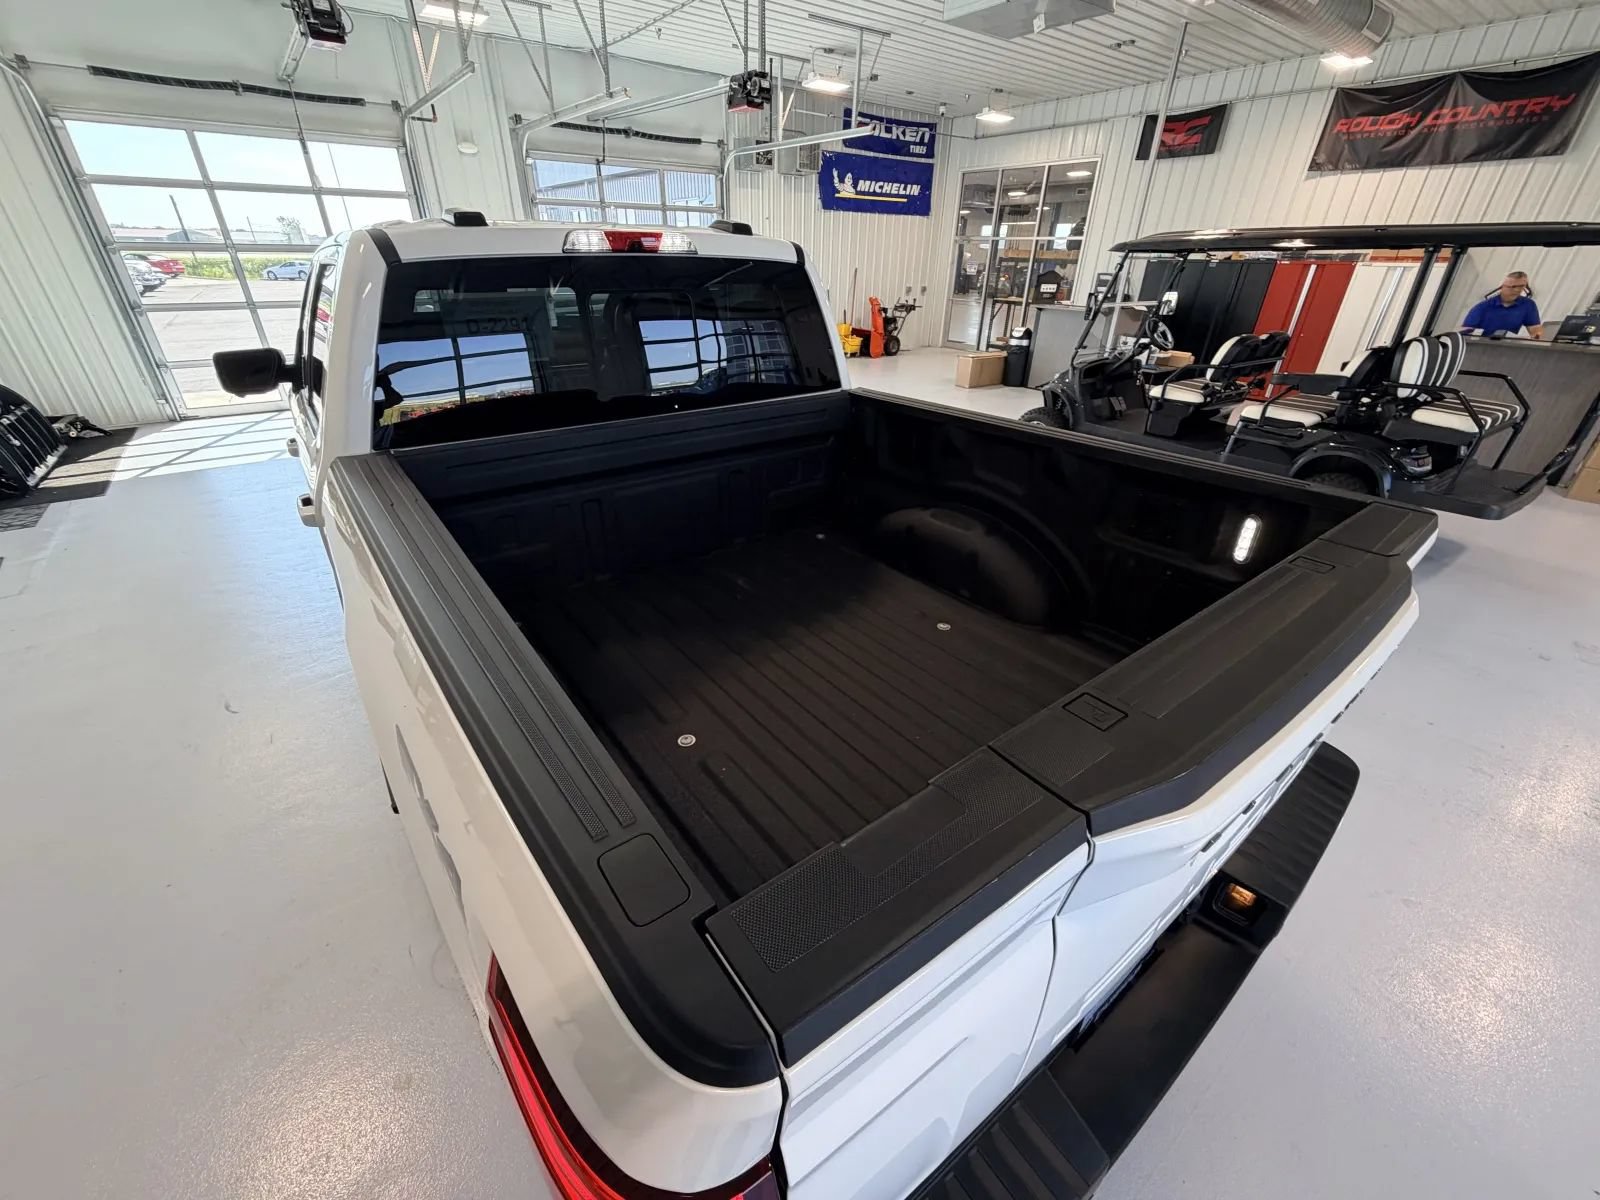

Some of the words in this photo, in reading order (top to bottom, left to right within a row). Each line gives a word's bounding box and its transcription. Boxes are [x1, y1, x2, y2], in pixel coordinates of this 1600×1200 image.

[1333, 111, 1422, 133] ROUGH
[1424, 93, 1577, 126] COUNTRY
[909, 145, 927, 154] TIRES
[857, 180, 921, 196] MICHELIN
